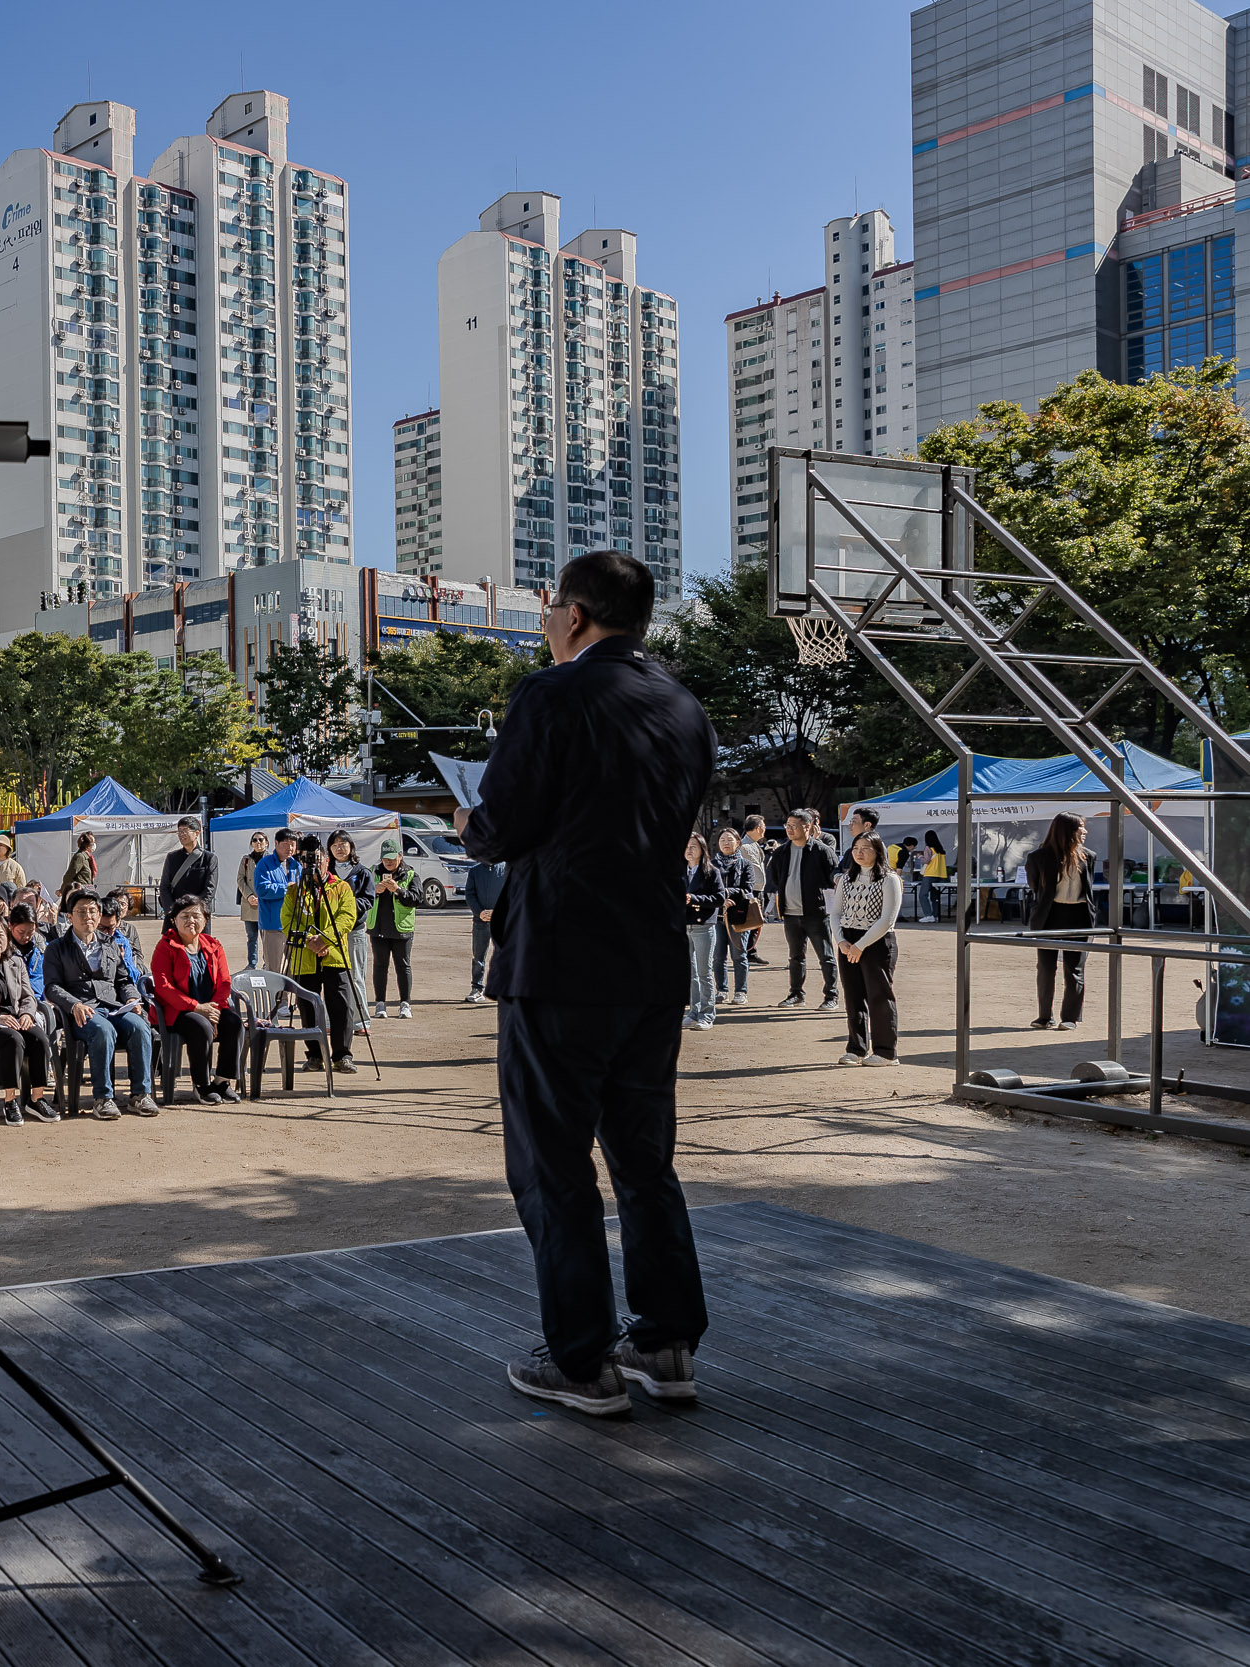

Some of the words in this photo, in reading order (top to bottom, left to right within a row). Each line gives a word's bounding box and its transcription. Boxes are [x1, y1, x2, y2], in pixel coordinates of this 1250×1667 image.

[12, 256, 20, 272] 4
[465, 315, 478, 331] 11
[926, 809, 939, 817] 세계
[990, 803, 1019, 814] 간식체험
[105, 822, 117, 830] 우리
[118, 822, 142, 830] 가족사진
